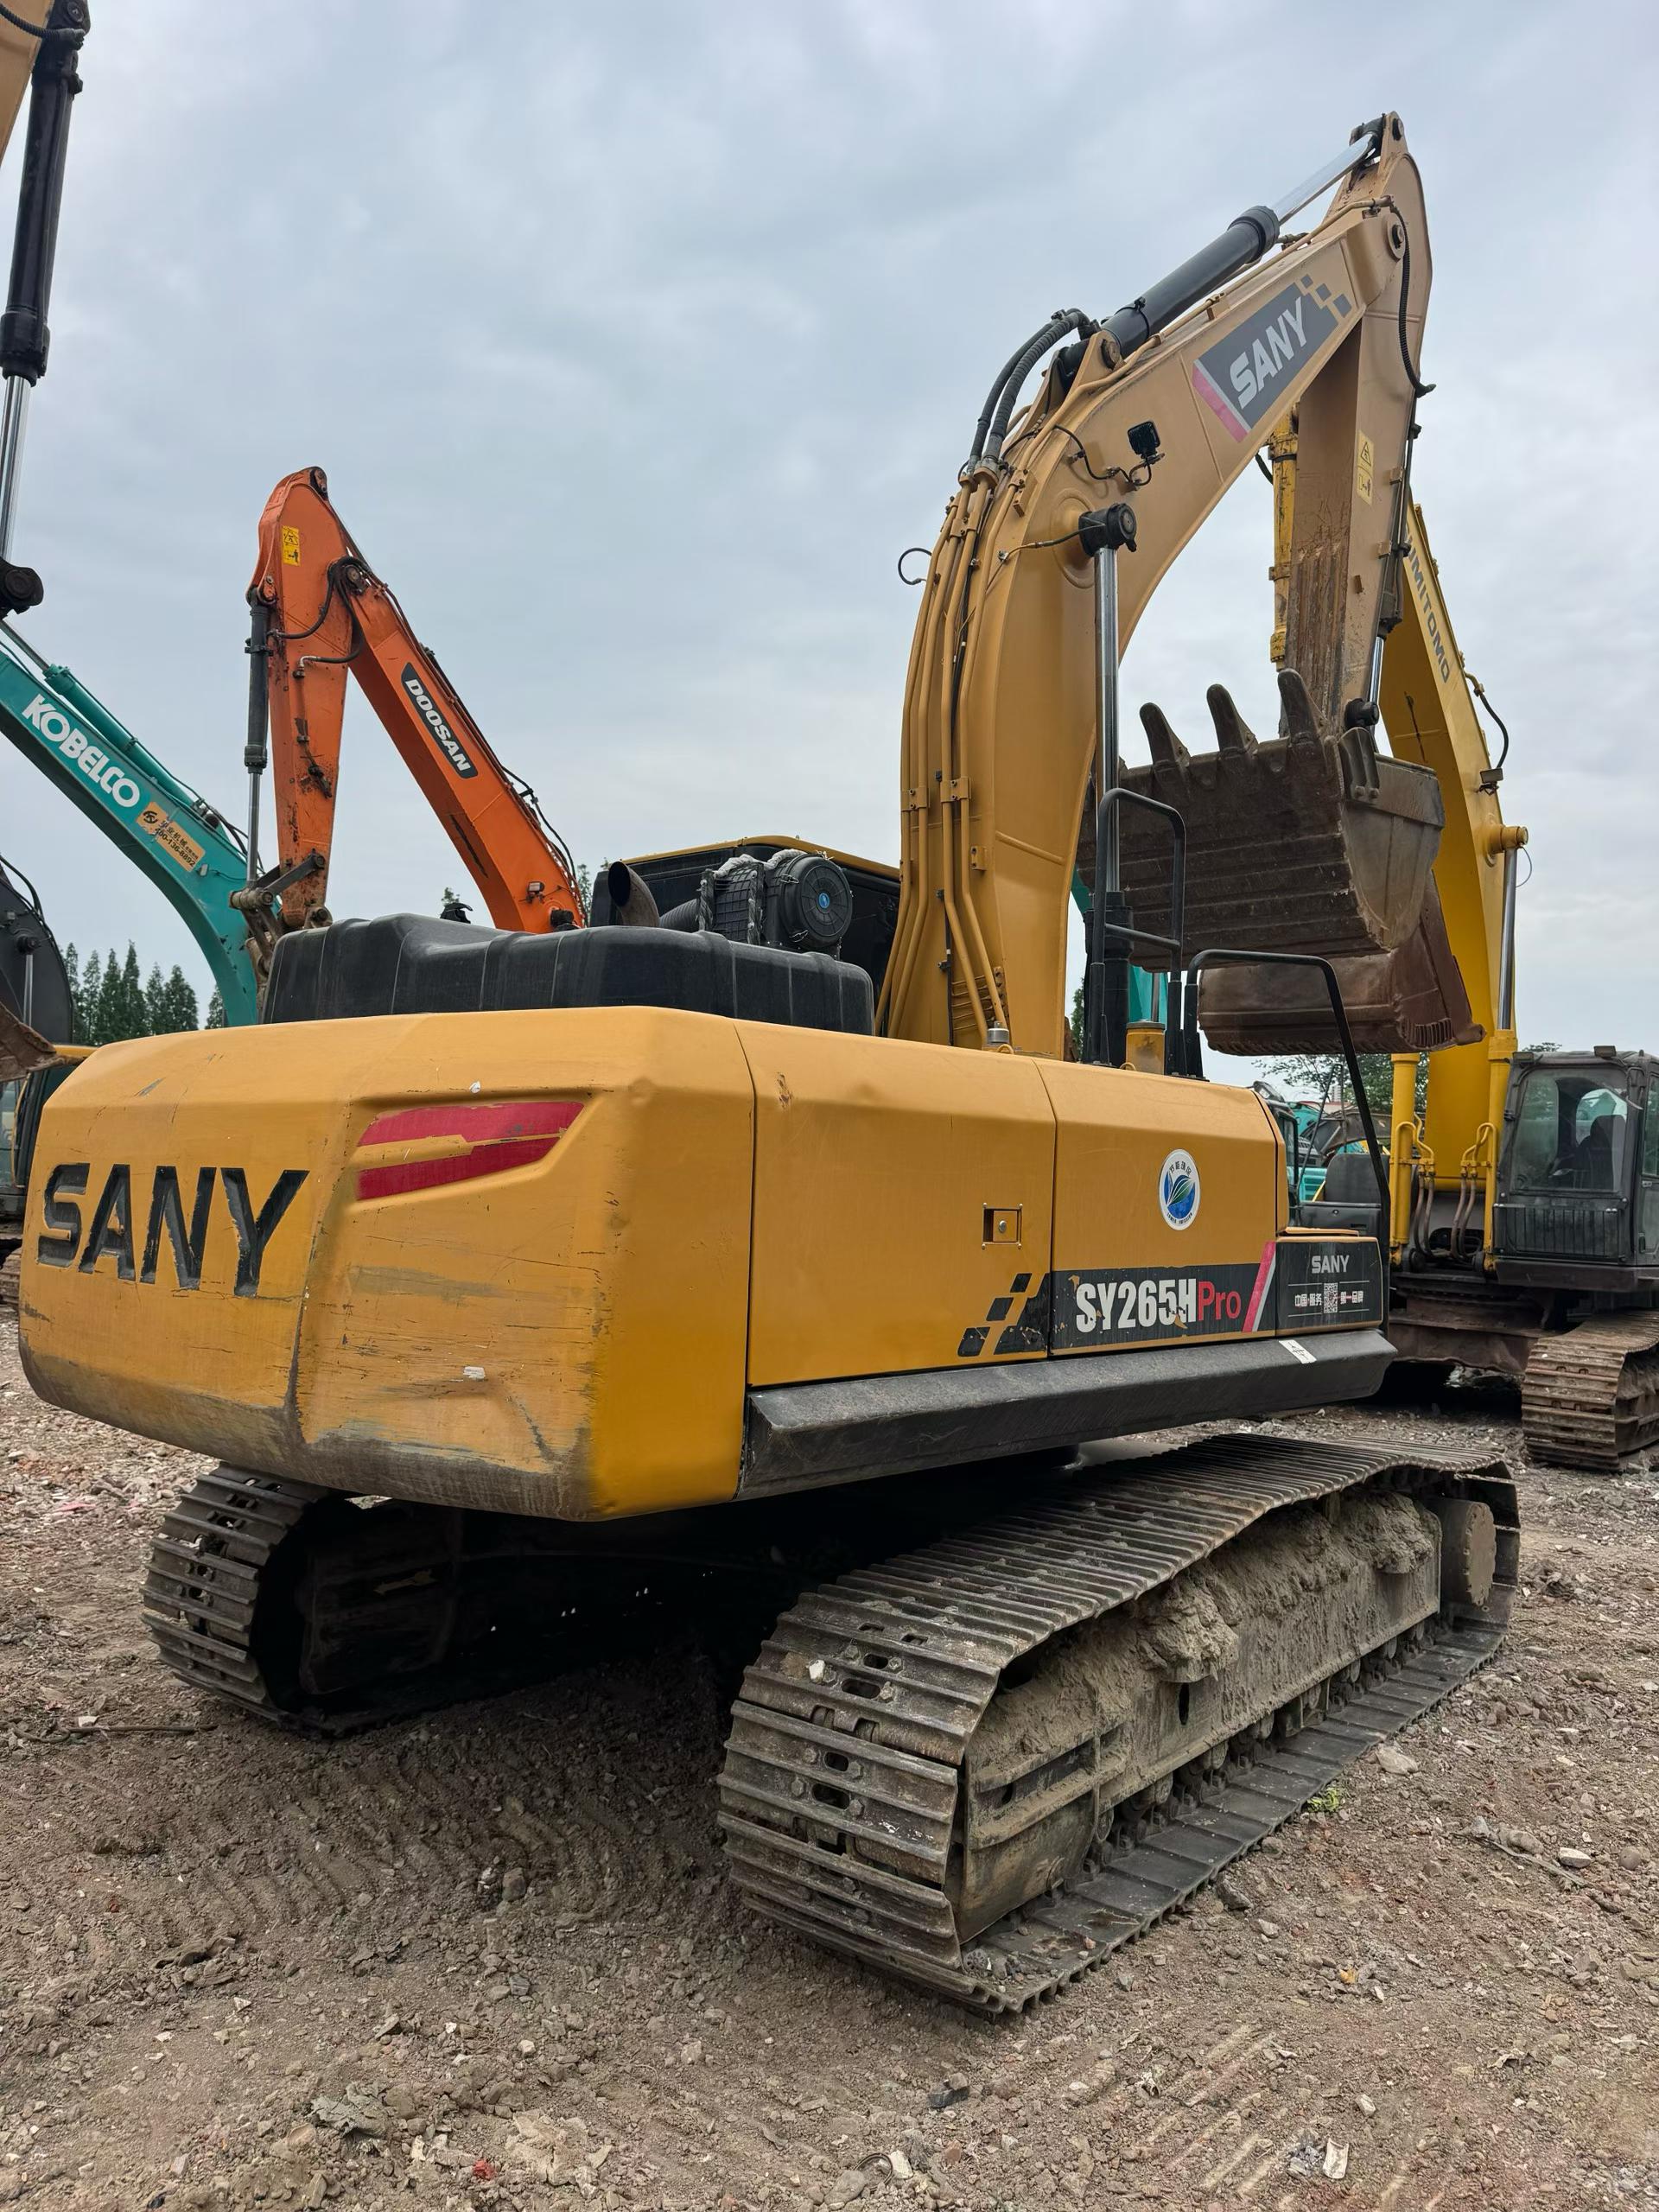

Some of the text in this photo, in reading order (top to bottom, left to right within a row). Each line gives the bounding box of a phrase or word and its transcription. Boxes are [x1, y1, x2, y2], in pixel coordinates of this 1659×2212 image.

[1230, 296, 1306, 410] SANY
[1406, 521, 1450, 683] UMITOMO
[22, 694, 140, 807] KOBELCO
[404, 679, 471, 771] DOOSAN
[36, 1163, 310, 1296] SANY
[1311, 1255, 1350, 1274] SANY
